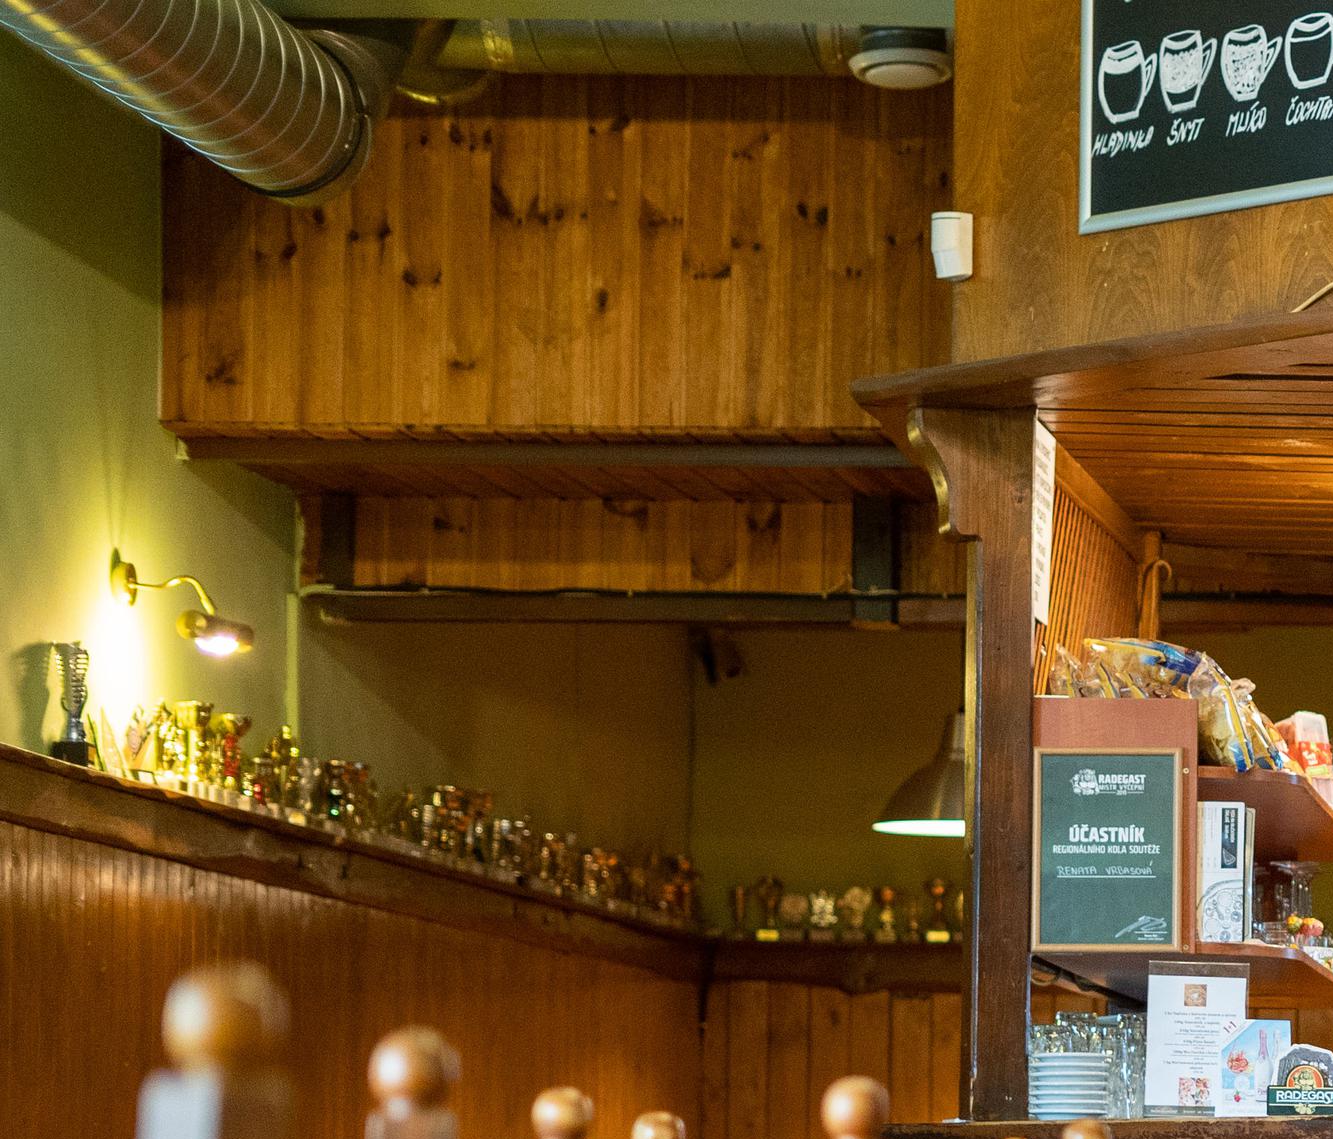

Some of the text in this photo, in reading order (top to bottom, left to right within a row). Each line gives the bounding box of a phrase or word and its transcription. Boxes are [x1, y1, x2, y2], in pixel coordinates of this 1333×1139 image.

[1092, 126, 1154, 157] HLADINKA
[1166, 117, 1205, 146] ŠNYT
[1225, 101, 1267, 136] MLÍKO
[1098, 774, 1147, 784] RADEGAST
[1069, 824, 1145, 843] ÚČASTNÍK
[1052, 844, 1161, 854] REGIONÁLNÍHO KOLA SOUTĚŽE
[1056, 866, 1098, 875] RENATA
